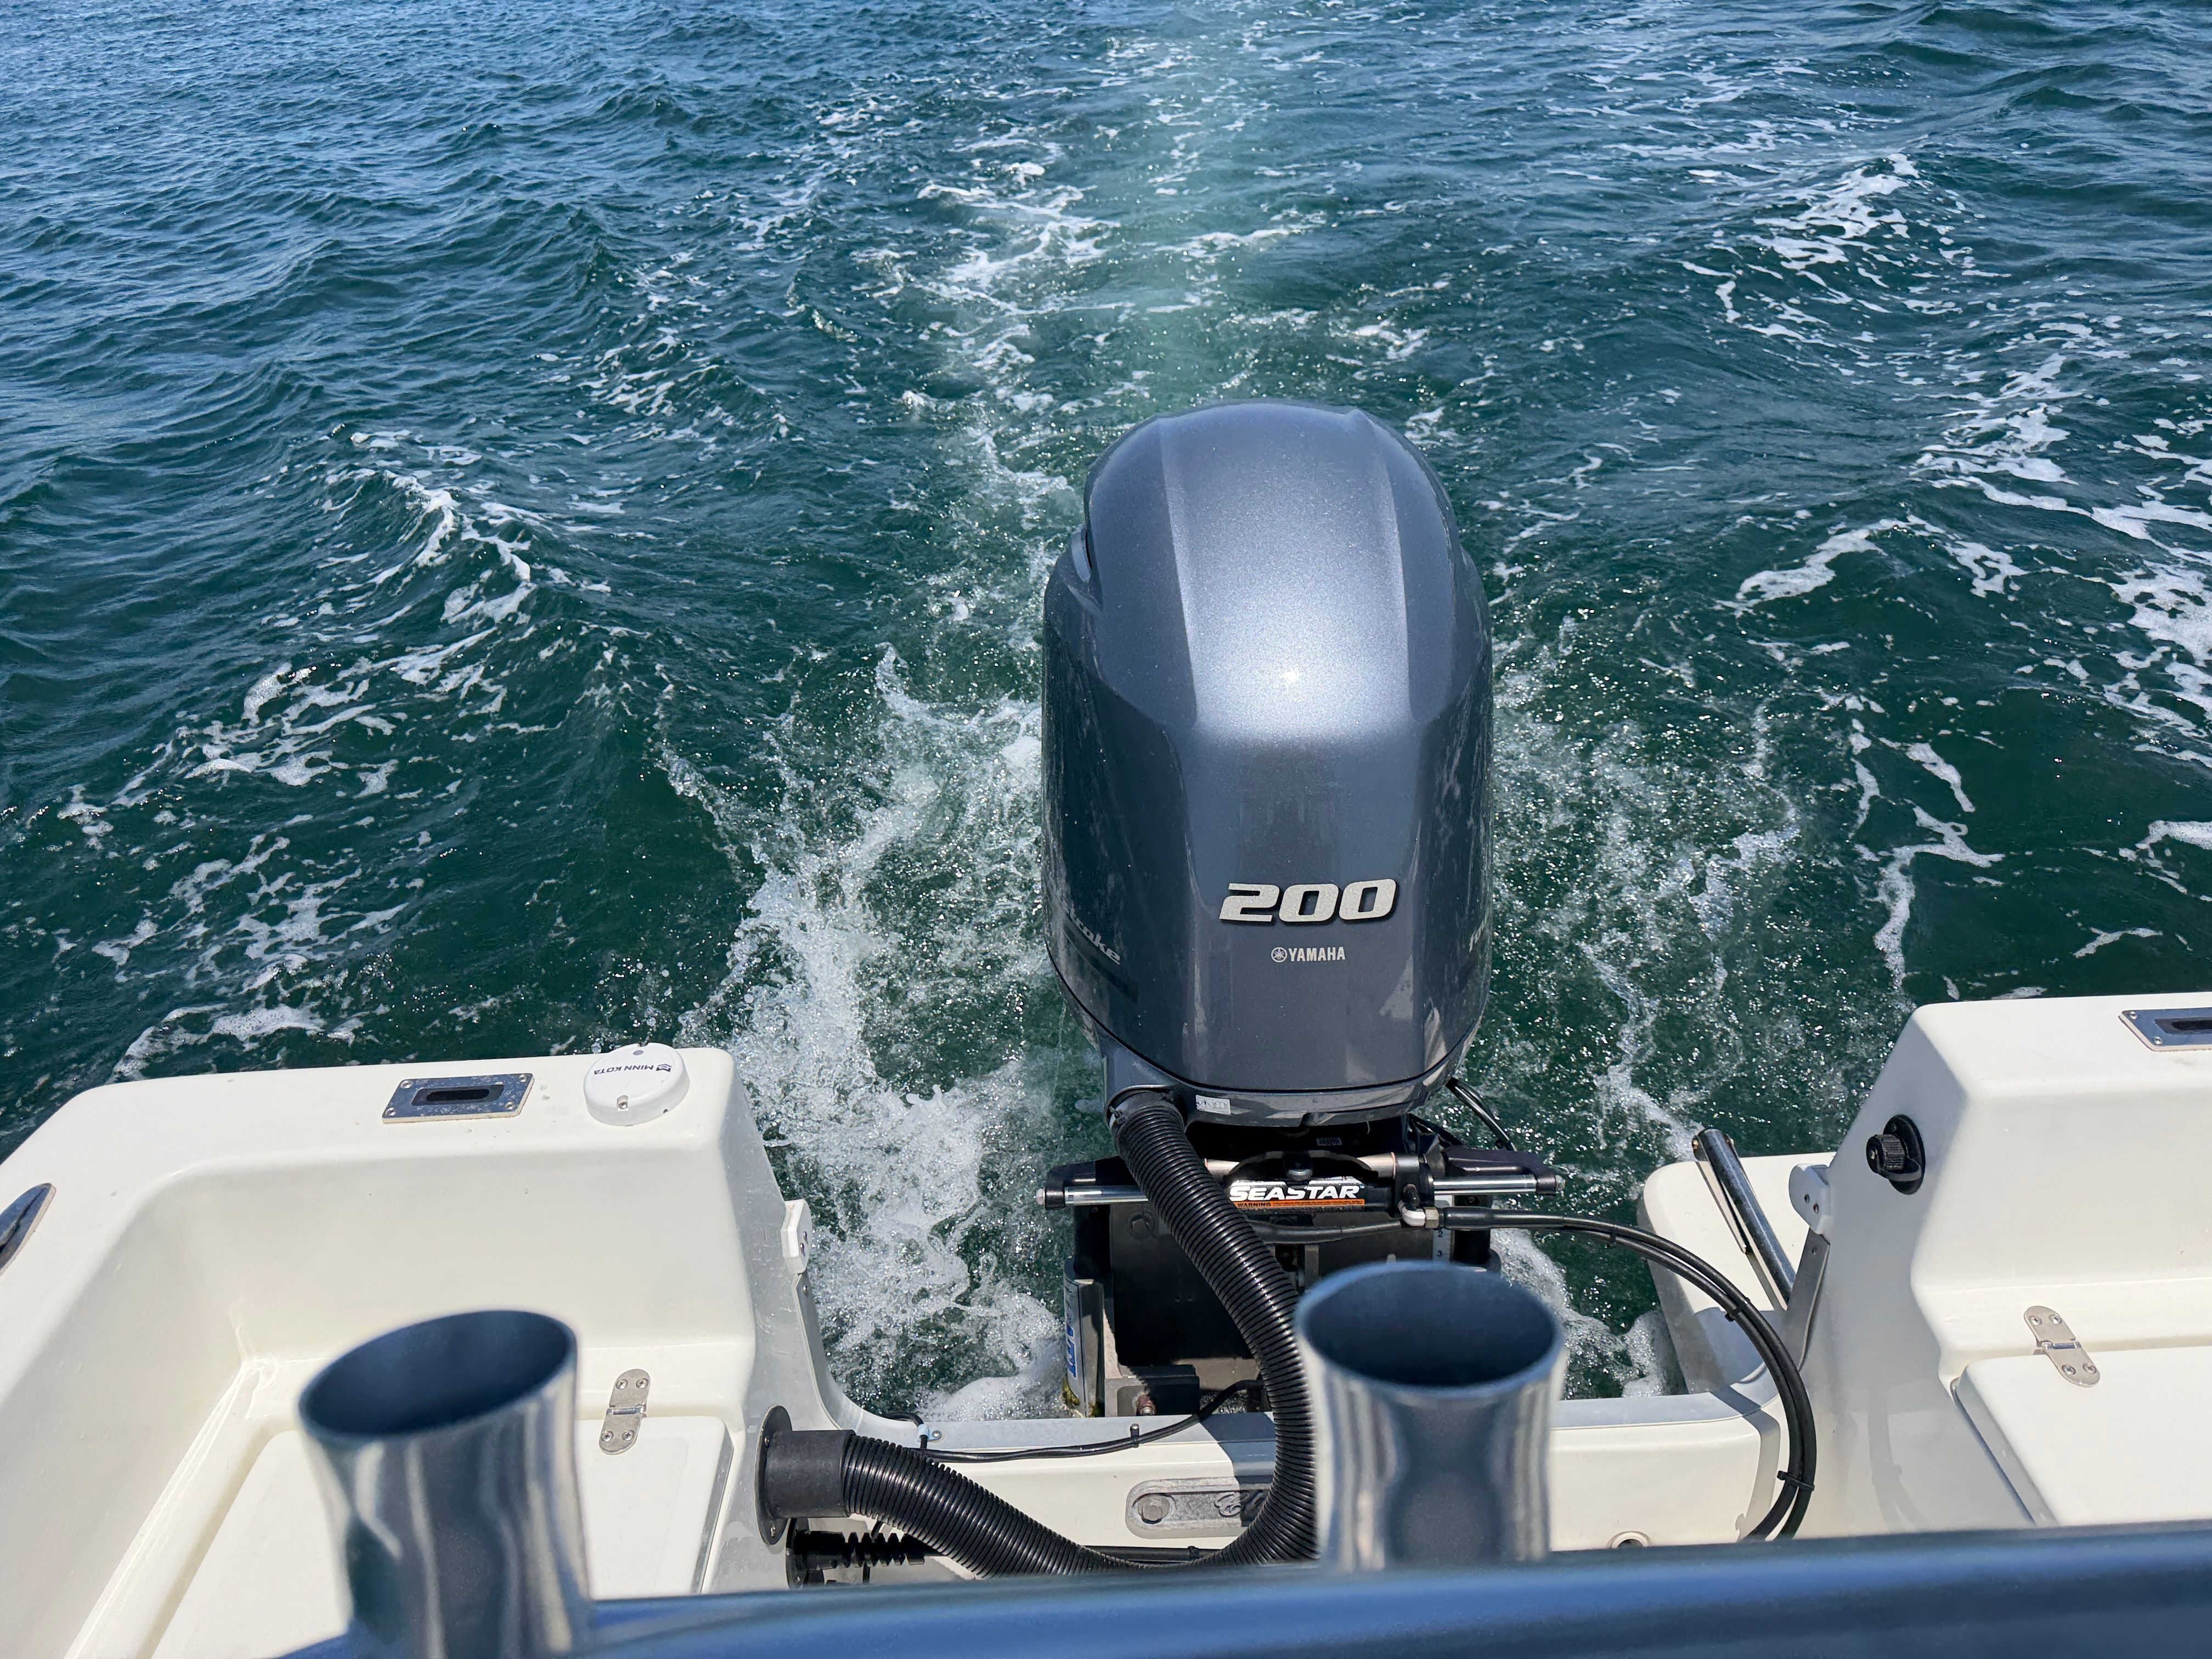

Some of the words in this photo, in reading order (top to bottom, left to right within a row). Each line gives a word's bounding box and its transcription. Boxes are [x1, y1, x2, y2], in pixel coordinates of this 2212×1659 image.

[1219, 879, 1397, 923] 200
[1289, 946, 1345, 962] YAMAHA
[594, 1066, 622, 1075] KOTA
[1229, 1186, 1360, 1201] SEASTAR
